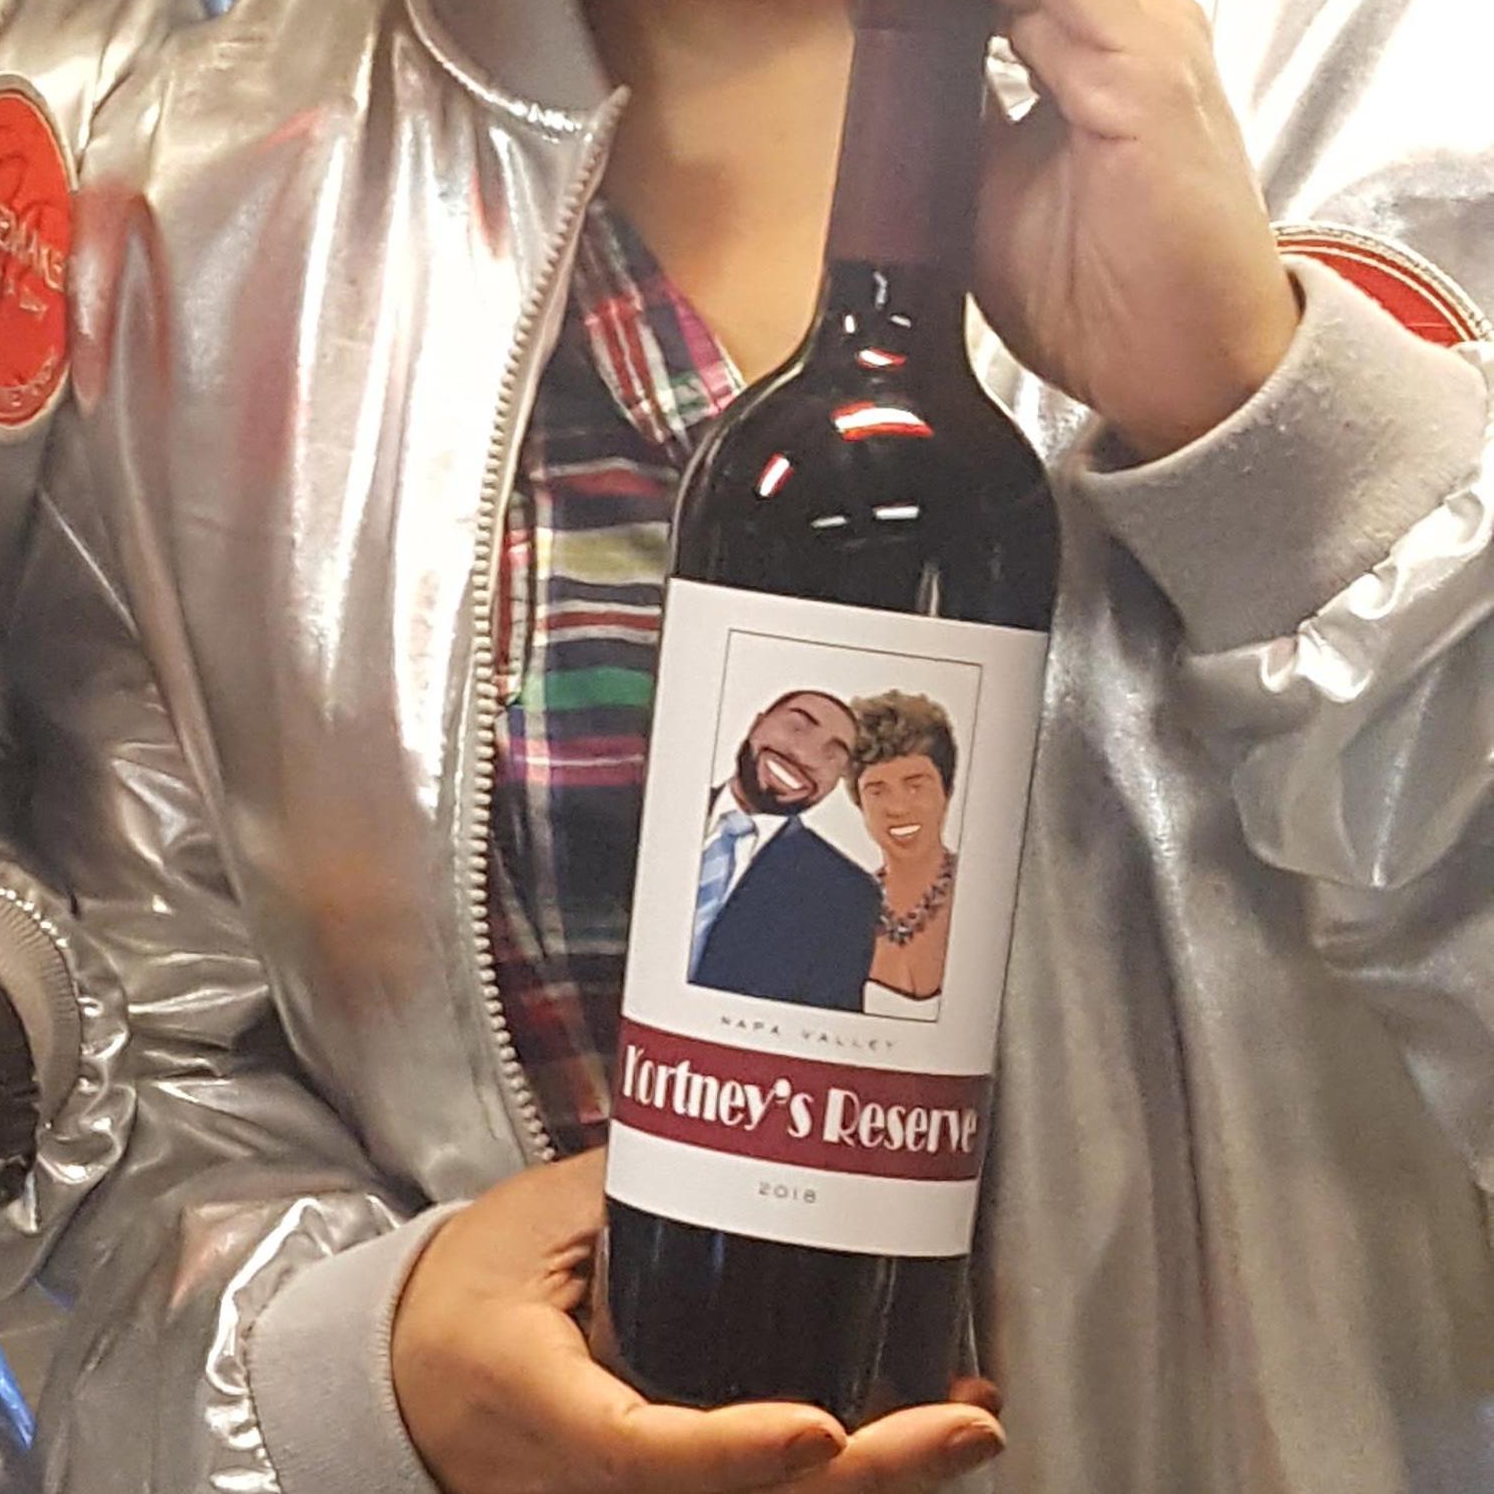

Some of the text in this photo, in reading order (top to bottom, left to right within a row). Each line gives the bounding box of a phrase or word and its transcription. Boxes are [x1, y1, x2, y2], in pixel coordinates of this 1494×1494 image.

[720, 1015, 896, 1051] NAPA VALLEY
[822, 1087, 979, 1154] Reserve
[758, 1180, 817, 1204] 2018
